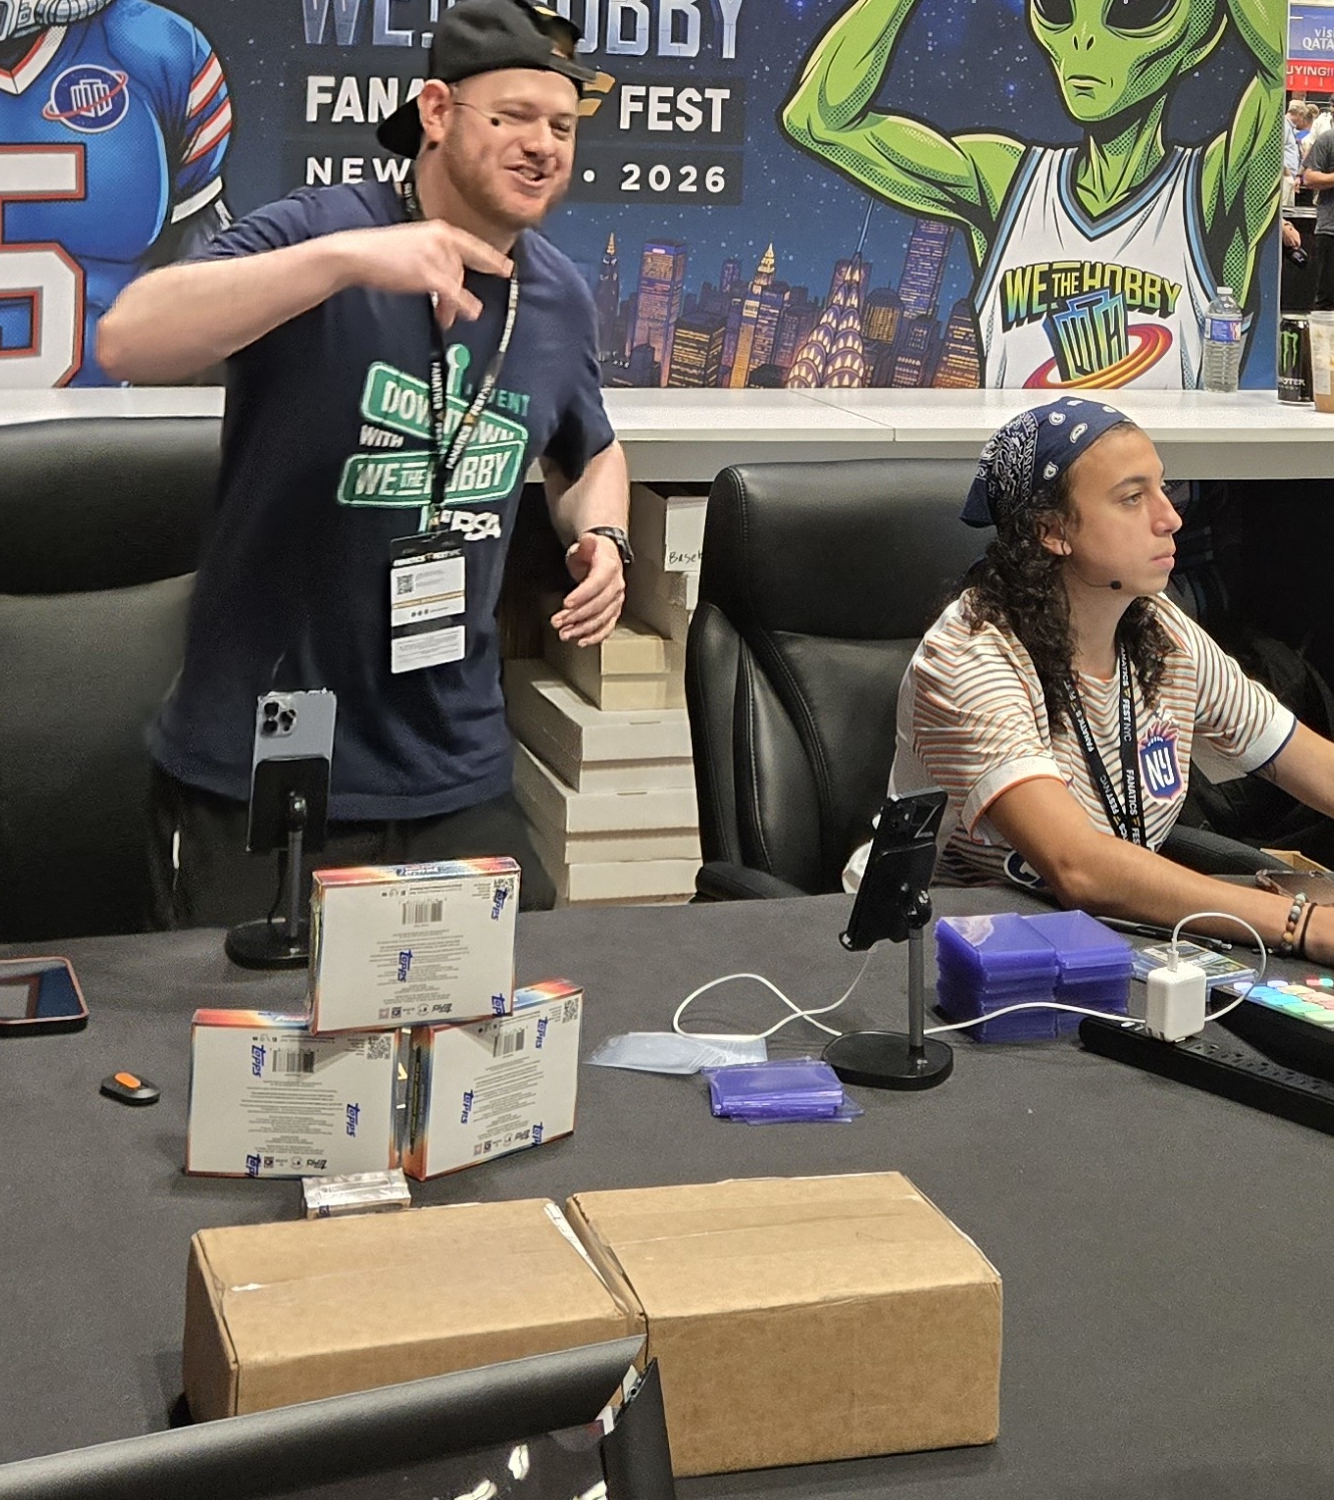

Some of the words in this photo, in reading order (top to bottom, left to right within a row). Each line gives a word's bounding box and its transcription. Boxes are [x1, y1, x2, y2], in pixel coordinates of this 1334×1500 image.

[619, 84, 731, 134] FEST
[305, 155, 414, 186] NEW
[620, 162, 727, 194] 2026
[1001, 263, 1052, 332] WE
[1051, 270, 1080, 299] THE
[1082, 261, 1183, 319] HOBBY
[358, 424, 405, 448] WITH
[354, 461, 401, 496] WE
[399, 469, 425, 489] THE
[424, 451, 512, 495] BBY
[1122, 698, 1132, 724] FEST
[1123, 722, 1133, 743] NYC
[1125, 768, 1139, 816] FANATICS
[1131, 827, 1143, 848] FES
[491, 886, 509, 921] topps
[397, 949, 414, 983] topps
[491, 993, 507, 1018] top
[534, 1017, 549, 1050] topps
[250, 1043, 267, 1079] topps
[345, 1102, 361, 1139] topps
[460, 1088, 475, 1125] topps
[532, 1121, 545, 1147] top
[245, 1153, 262, 1178] top
